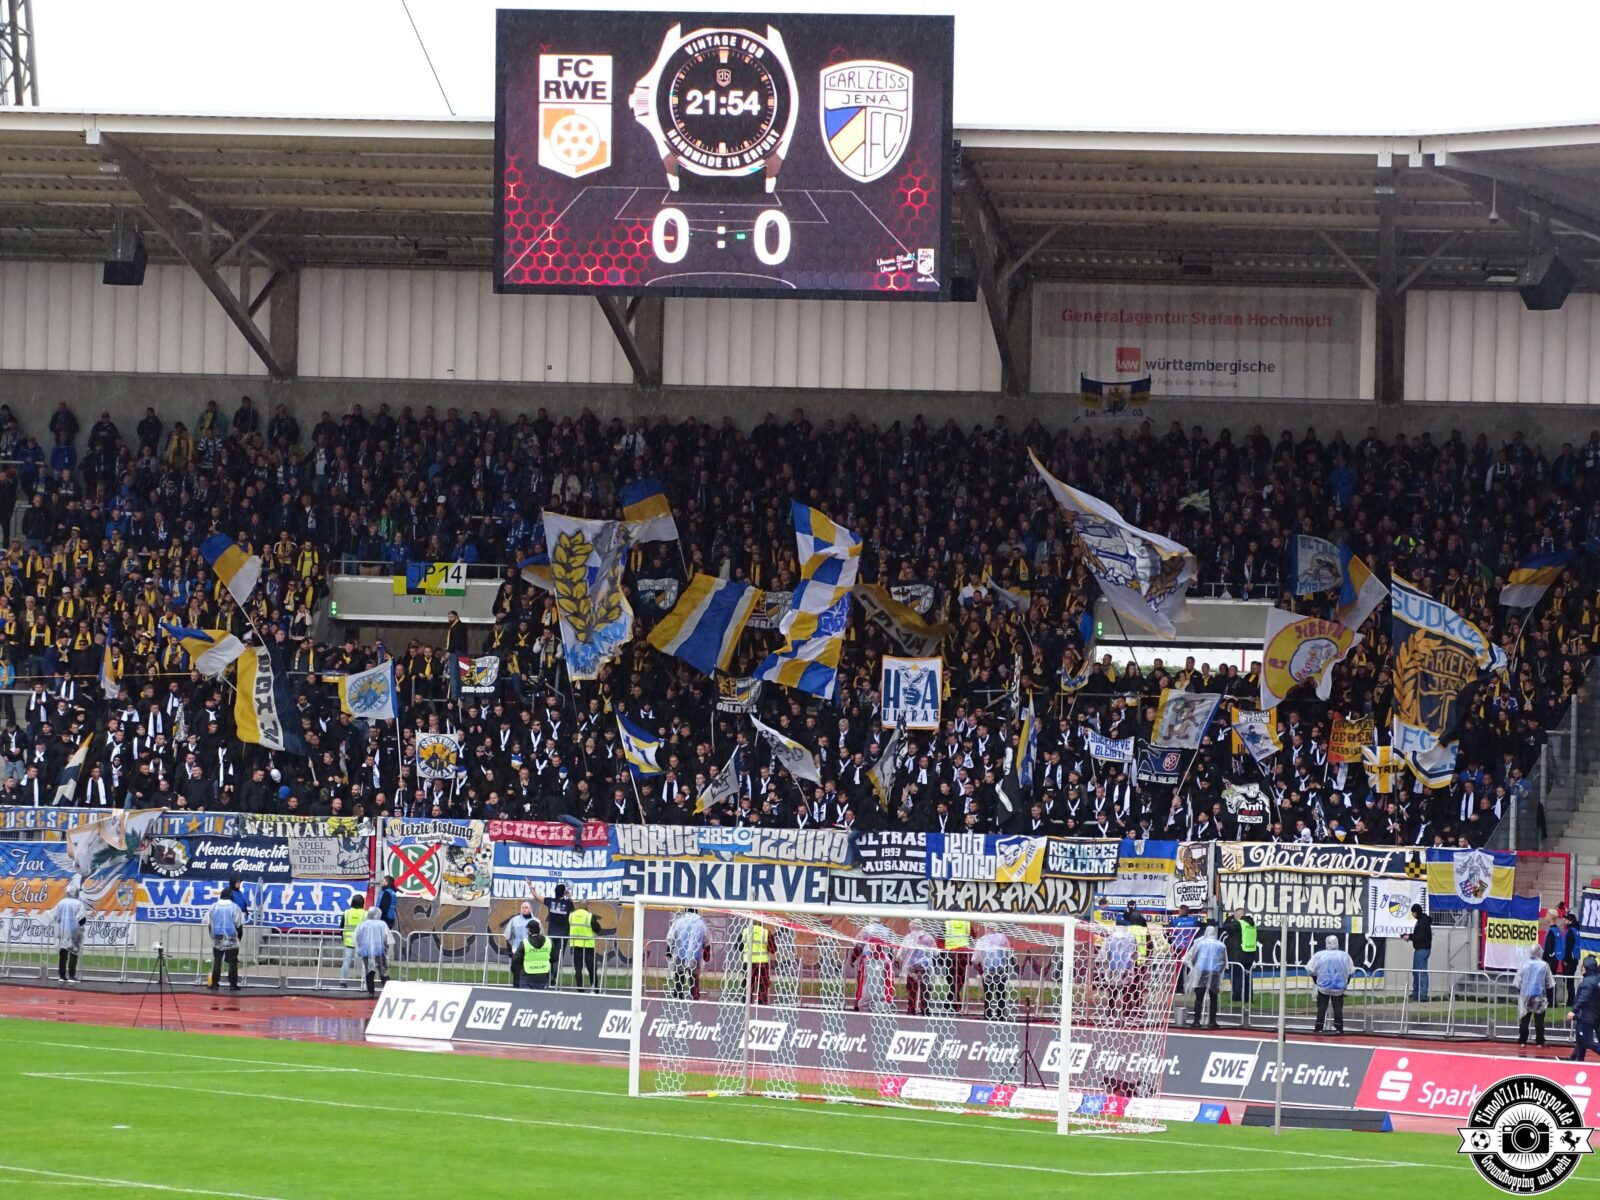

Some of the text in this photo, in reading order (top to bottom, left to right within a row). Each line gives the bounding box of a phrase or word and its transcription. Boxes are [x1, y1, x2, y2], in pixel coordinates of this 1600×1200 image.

[684, 35, 737, 56] VINTAGE
[557, 58, 594, 78] FC
[828, 69, 905, 90] CARL ZEISS
[544, 80, 607, 100] RWE
[841, 93, 892, 105] JENA
[685, 89, 762, 116] 21:54
[666, 128, 780, 168] HANDMADE IN ERFURT
[653, 207, 690, 264] 0
[753, 209, 791, 266] 0
[1061, 308, 1333, 328] Generalagentur Stefan Hochmuth
[1145, 356, 1276, 375] württembergische
[1239, 801, 1263, 811] Anti
[203, 816, 235, 836] UNS
[244, 819, 333, 838] WEIMAR
[1238, 815, 1263, 823] ACTION
[489, 820, 608, 841] SCHICKEIA
[297, 841, 327, 850] SPIEL
[881, 847, 901, 858] 1993
[1049, 840, 1119, 860] REFUGEES
[8, 848, 45, 875] Fan
[191, 860, 207, 870] aus
[210, 858, 229, 871] dem
[299, 855, 325, 864] DEIN
[508, 846, 608, 868] UNBEUGSAM
[862, 860, 926, 873] AUSANNE
[1048, 856, 1117, 875] WELCOME
[1250, 843, 1400, 878] Rockendorf
[10, 880, 48, 904] Club
[621, 860, 828, 905] SÜDKURVE
[834, 878, 930, 903] ULTRAS
[145, 879, 353, 912] WEMAR
[1219, 882, 1364, 916] WOLFPACK
[148, 907, 177, 919] ist
[1488, 922, 1538, 941] EISENBERG
[473, 1005, 505, 1024] SWE
[512, 1008, 537, 1028] Für
[537, 1010, 583, 1032] Erfurt.
[648, 1017, 675, 1038] Für
[674, 1019, 722, 1042] Erfurt.
[748, 1025, 781, 1045] SWE
[790, 1027, 817, 1050] Für
[817, 1031, 868, 1054] Erfurt.
[896, 1034, 930, 1057] SWE
[939, 1038, 968, 1060] Für
[967, 1041, 1021, 1065] Erfurt.
[1097, 1048, 1126, 1073] Für
[1126, 1051, 1181, 1076] Erfurt.
[1209, 1057, 1249, 1080] SWE
[1292, 1063, 1351, 1089] Erfurt.
[1417, 1080, 1480, 1110] Spark
